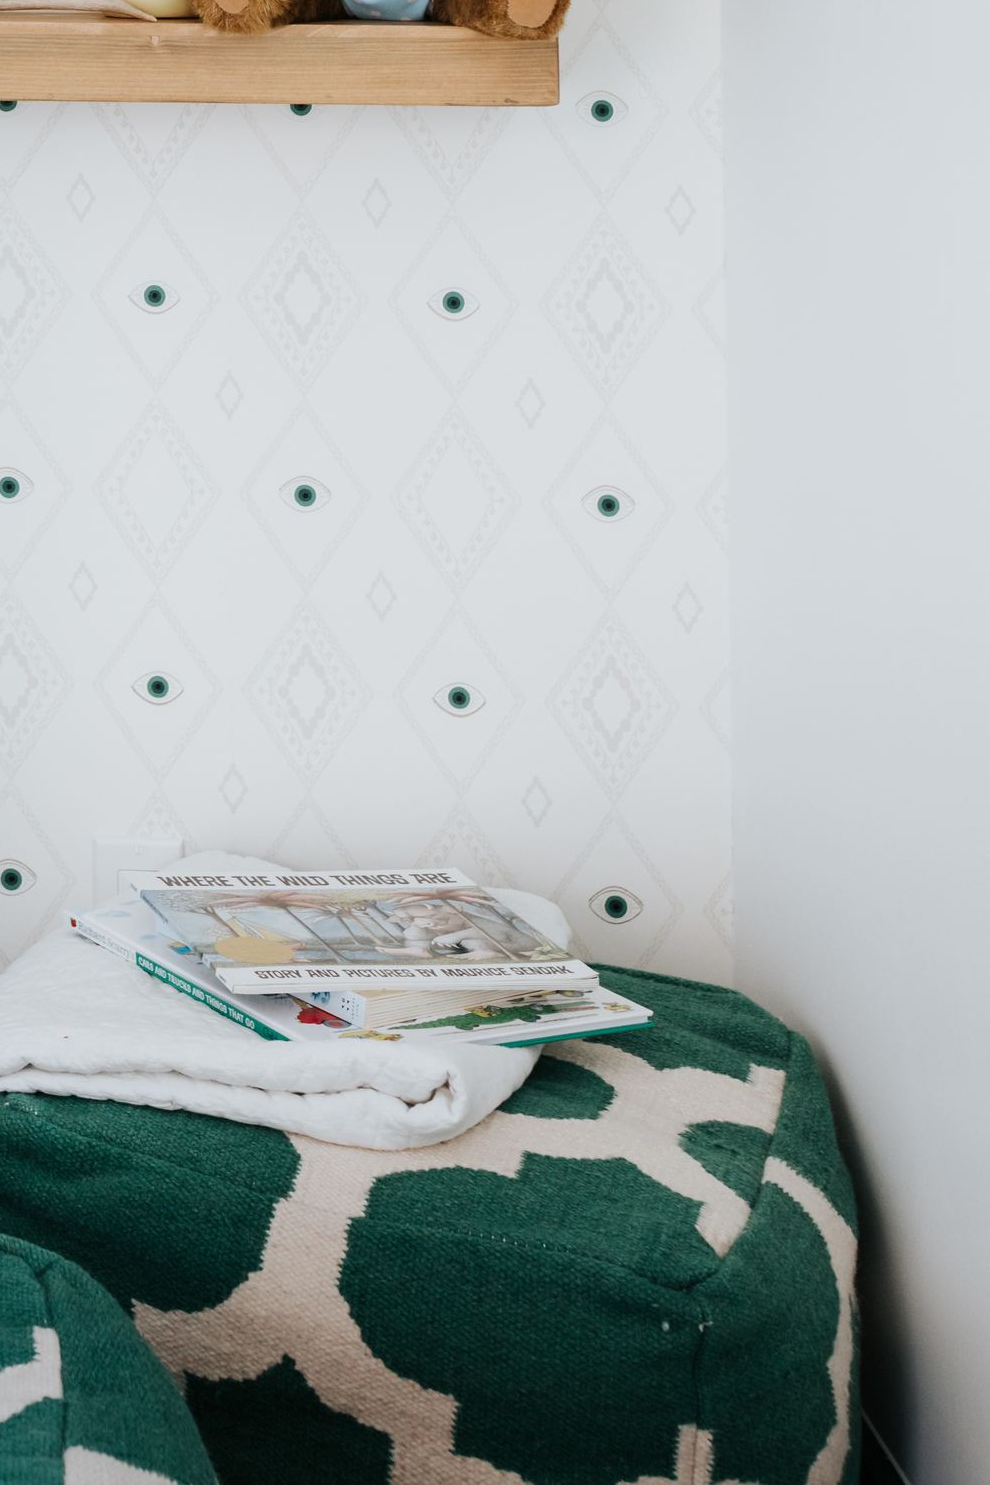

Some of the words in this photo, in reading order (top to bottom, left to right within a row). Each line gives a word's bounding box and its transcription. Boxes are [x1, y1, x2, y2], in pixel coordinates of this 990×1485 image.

[157, 876, 234, 887] WHERE
[232, 876, 276, 886] THE
[276, 875, 330, 886] WILD
[330, 875, 410, 885] THINGS
[408, 873, 457, 884] ARE
[254, 969, 302, 979] STORY
[305, 969, 340, 978] AND
[342, 969, 416, 977] PICTURES
[414, 969, 438, 977] BY
[440, 967, 511, 977] MAURICE
[510, 966, 575, 975] SENDAK
[138, 956, 154, 972] CARS
[155, 966, 167, 979] AND
[168, 974, 192, 993] TRUCKS
[192, 987, 204, 1000] AND
[205, 994, 227, 1013] THINGS
[228, 1007, 244, 1024] THAT
[245, 1017, 255, 1029] GO
